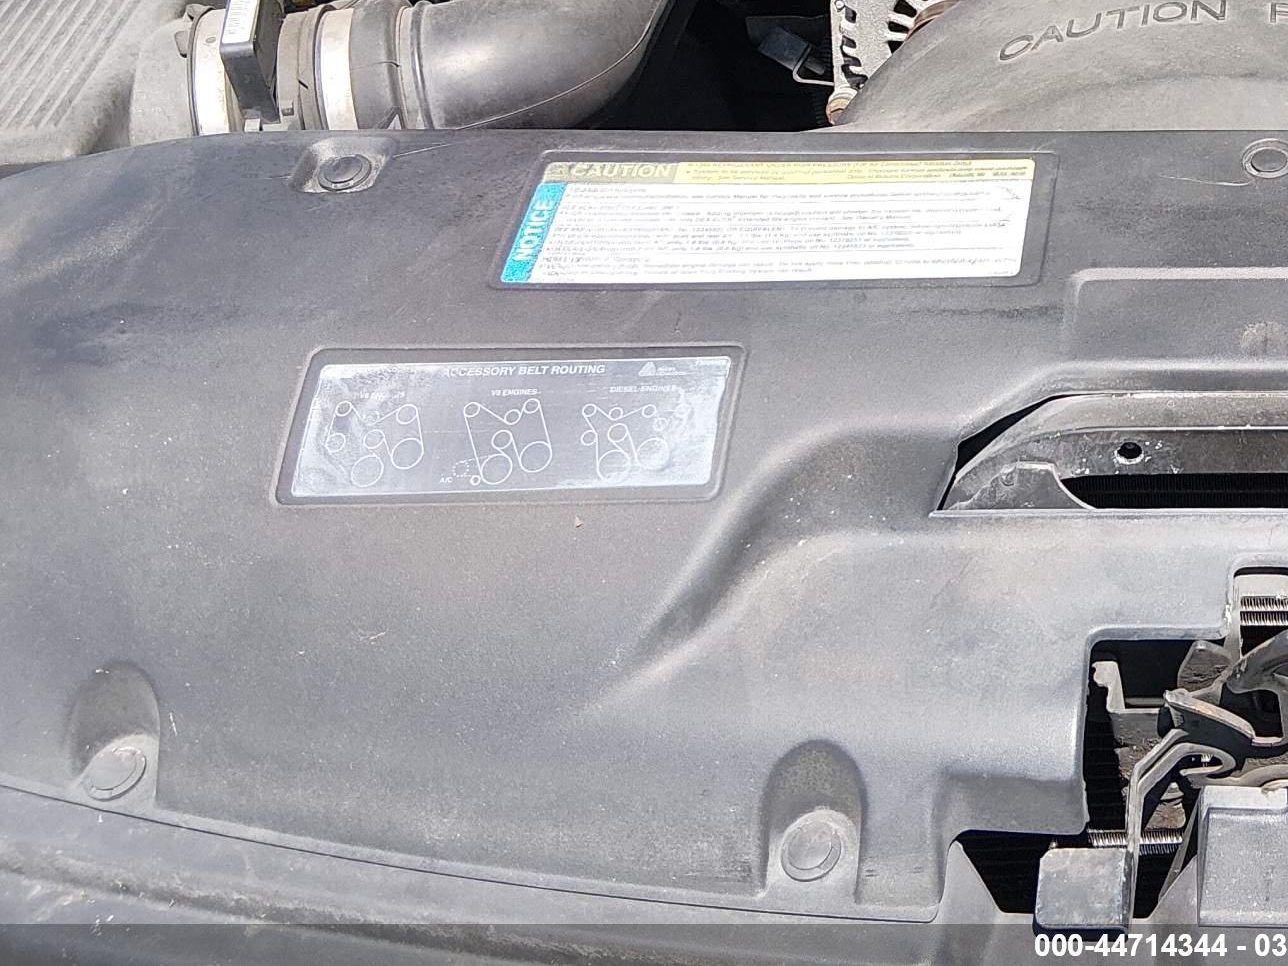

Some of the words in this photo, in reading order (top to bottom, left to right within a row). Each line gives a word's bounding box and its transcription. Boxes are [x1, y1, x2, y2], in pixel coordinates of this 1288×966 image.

[998, 0, 1228, 62] CAUTION
[570, 163, 675, 179] CAUTION
[514, 200, 552, 262] NOTICE
[518, 365, 548, 376] BELT
[551, 364, 606, 376] ROUTING
[502, 388, 538, 396] ENGINES
[609, 385, 639, 393] DIESEL
[439, 476, 453, 484] A/C
